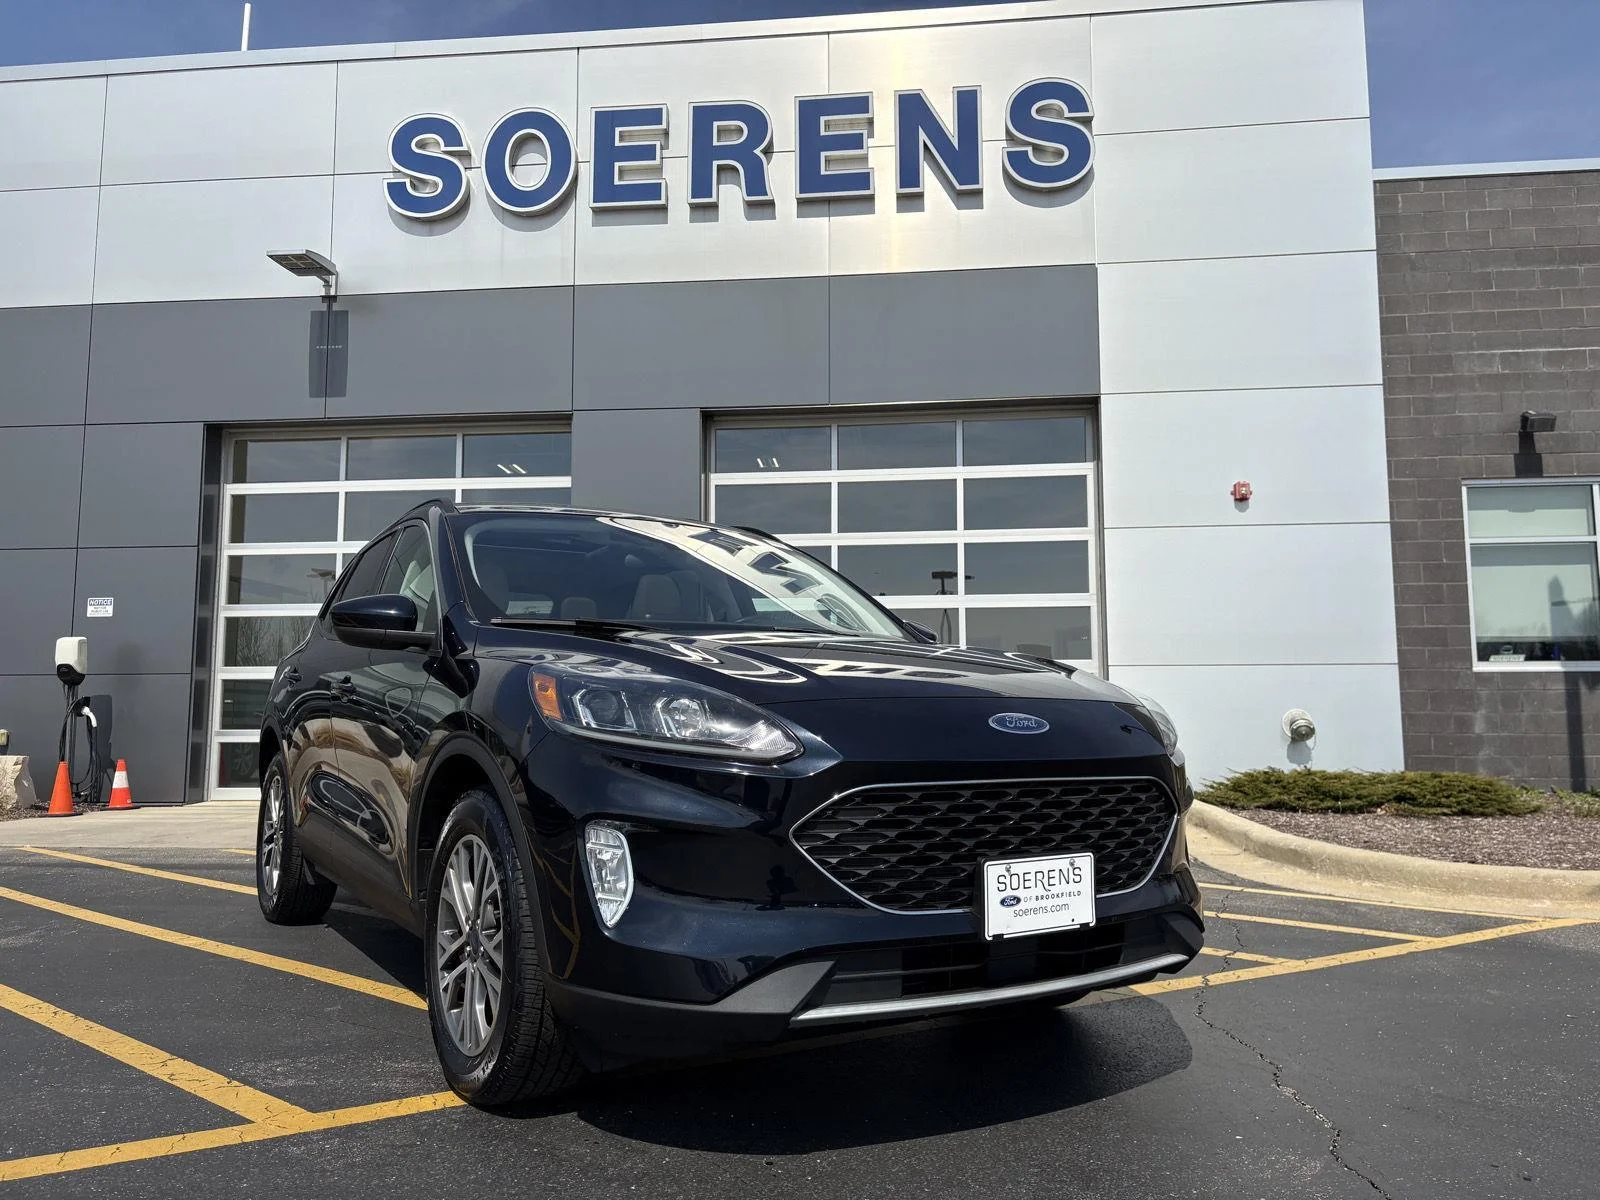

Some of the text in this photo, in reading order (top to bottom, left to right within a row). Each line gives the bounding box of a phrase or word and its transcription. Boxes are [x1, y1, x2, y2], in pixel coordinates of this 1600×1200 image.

[382, 76, 1096, 221] SOERENS
[996, 866, 1083, 893] SOERENS
[1023, 890, 1082, 903] OF BROOKFIELD
[1013, 903, 1070, 918] soerens.com
